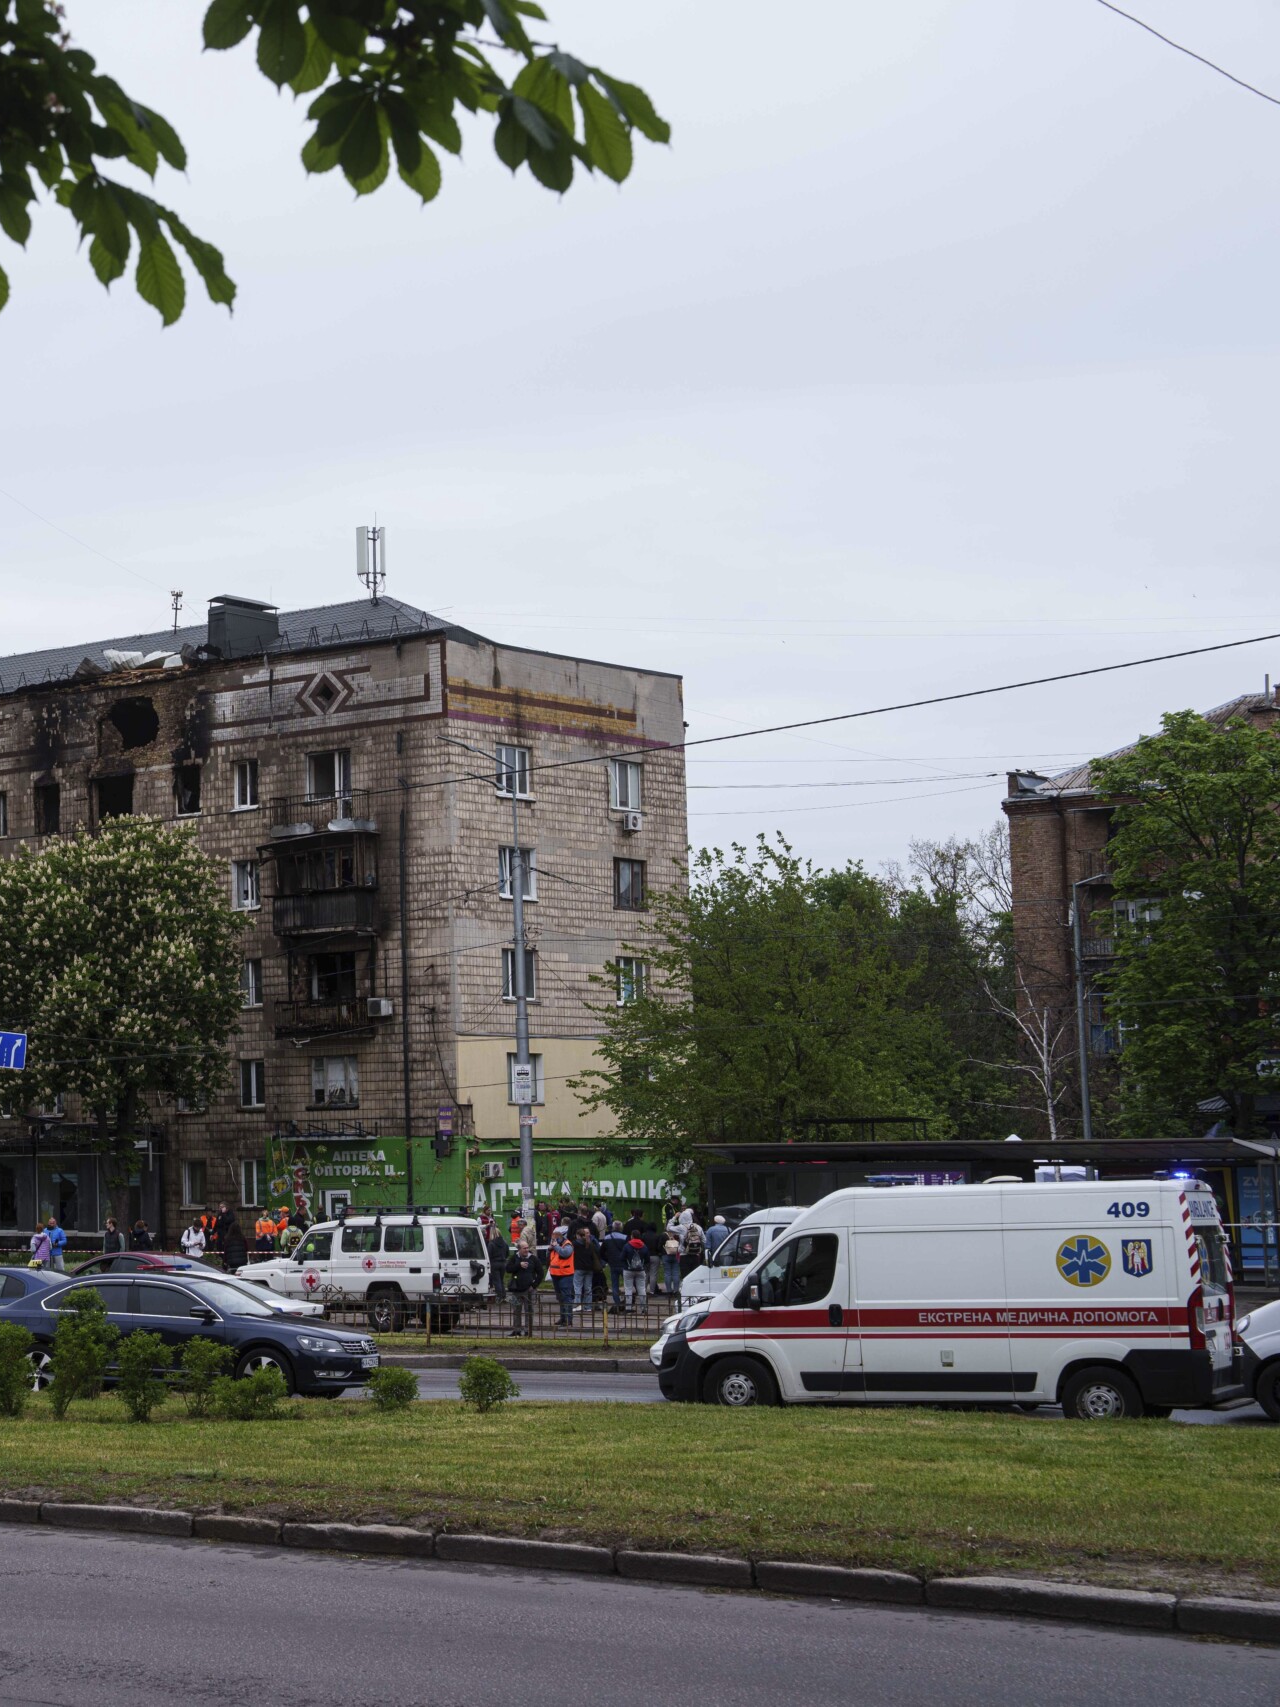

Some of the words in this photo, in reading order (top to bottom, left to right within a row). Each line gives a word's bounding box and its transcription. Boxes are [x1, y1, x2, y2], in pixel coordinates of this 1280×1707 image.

[332, 1150, 386, 1162] АПТЕКА
[314, 1164, 380, 1177] ОПТОВИХ
[1107, 1201, 1150, 1218] 409
[1188, 1200, 1216, 1218] AMBULANCE
[918, 1311, 992, 1323] ЕКСТРЕНА
[996, 1311, 1069, 1325] МЕДИЧНА
[1073, 1311, 1158, 1325] ДОПОМОГА
